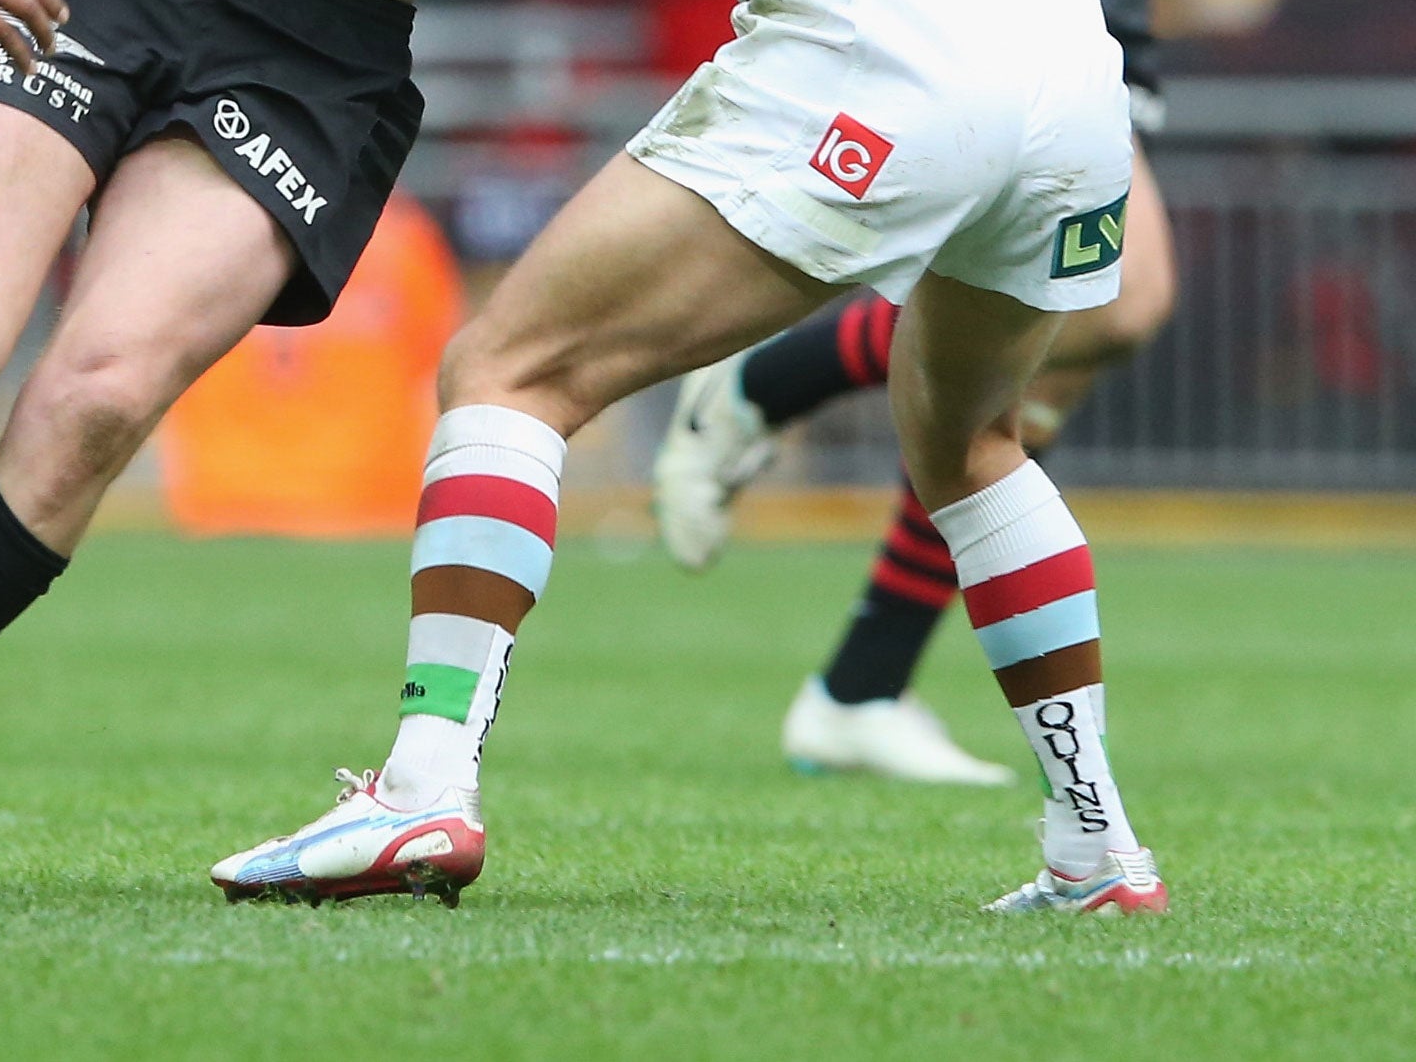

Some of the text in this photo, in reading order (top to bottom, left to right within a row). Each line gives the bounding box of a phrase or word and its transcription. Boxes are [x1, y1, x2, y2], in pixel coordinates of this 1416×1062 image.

[234, 132, 328, 226] AFEX
[817, 128, 872, 183] IG
[1035, 700, 1110, 834] QUINS
